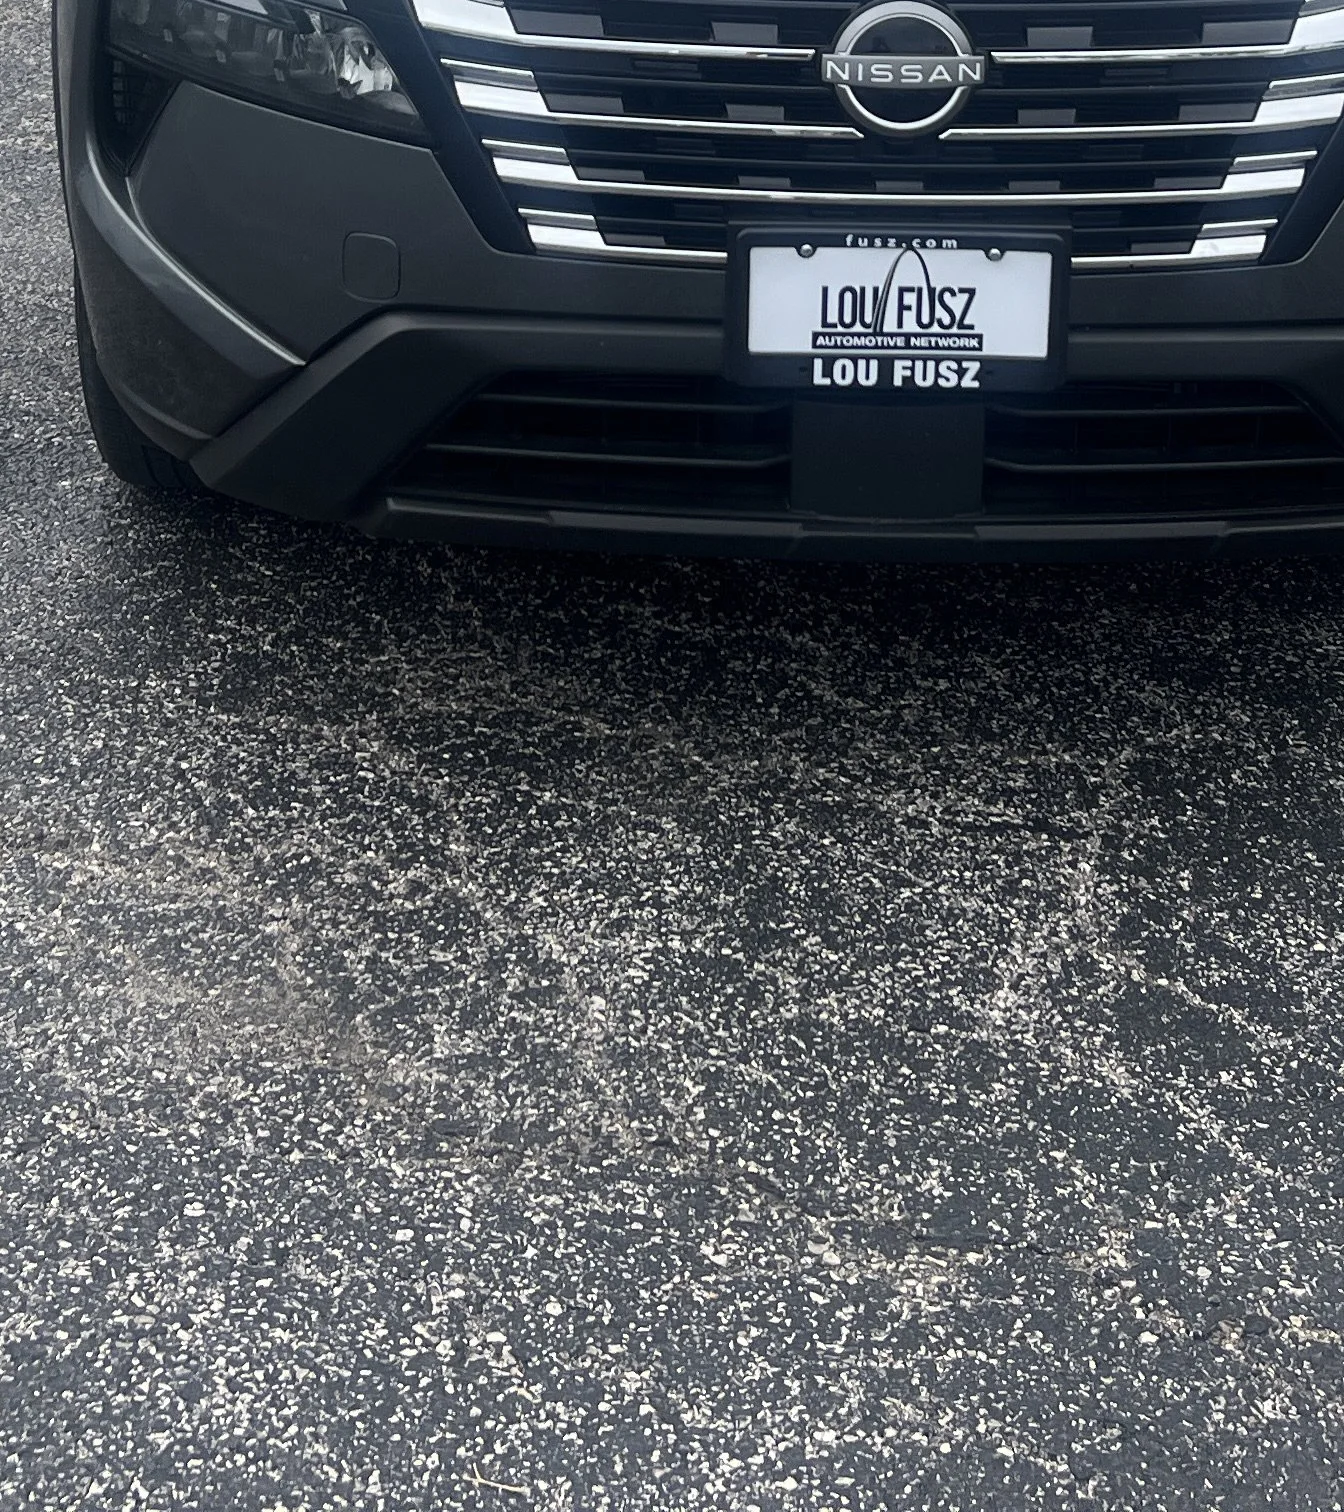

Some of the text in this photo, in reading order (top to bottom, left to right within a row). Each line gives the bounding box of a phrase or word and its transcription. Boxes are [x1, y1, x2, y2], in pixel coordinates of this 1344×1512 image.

[826, 60, 981, 84] NISSAN
[845, 234, 958, 248] fusz.com
[821, 285, 976, 330] LOU FUSZ
[816, 336, 979, 348] AUTOMOTIVE NETWORK
[813, 357, 981, 388] LOU FUSZ
